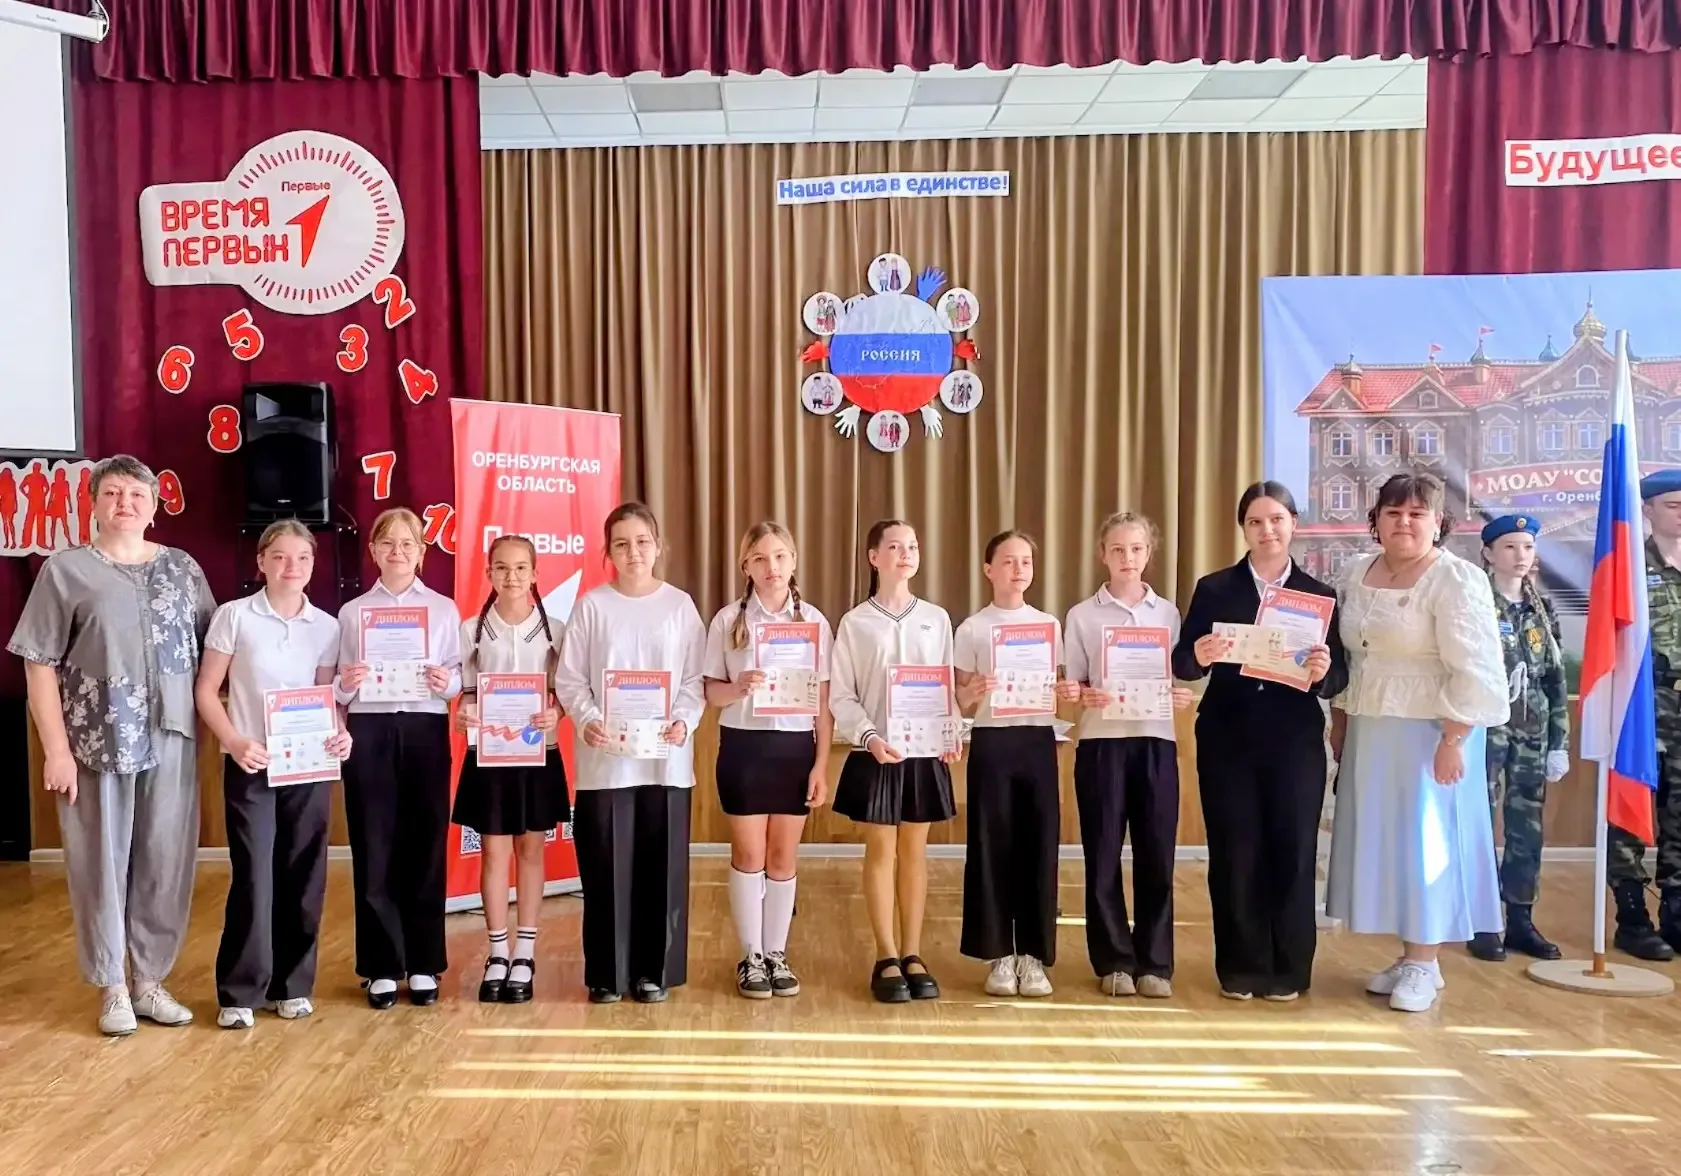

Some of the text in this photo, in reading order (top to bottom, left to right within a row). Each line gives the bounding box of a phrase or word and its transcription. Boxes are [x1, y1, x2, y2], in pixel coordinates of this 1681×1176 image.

[1510, 143, 1681, 183] Будущее
[281, 180, 332, 193] Первые
[779, 174, 1008, 199] Наша сила в единстве!
[161, 196, 270, 231] ВРЕМЯ
[163, 233, 289, 268] ПЕРВЫХ
[374, 275, 415, 328] 2
[223, 309, 263, 359] 5
[338, 325, 367, 371] 3
[861, 349, 921, 362] РОССИЯ
[158, 347, 193, 392] 6
[399, 360, 437, 403] 4
[208, 406, 240, 452] 8
[472, 451, 601, 474] ОРЕНБУРГСКАЯ
[363, 452, 395, 499] 7
[497, 474, 576, 494] ОБЛАСТЬ
[1486, 469, 1560, 494] МОАУ
[158, 470, 184, 514] 9
[483, 525, 584, 555] Пвые
[375, 614, 420, 624] ДИПЛОМ
[767, 630, 811, 640] ДИПЛОМ
[1005, 630, 1046, 641] ДИПЛОМ
[1117, 634, 1161, 643] ДИПЛОМ
[493, 680, 537, 690] ДИПЛОМ
[618, 676, 662, 685] ДИПЛОМ
[900, 673, 943, 682] ДИПЛОМ
